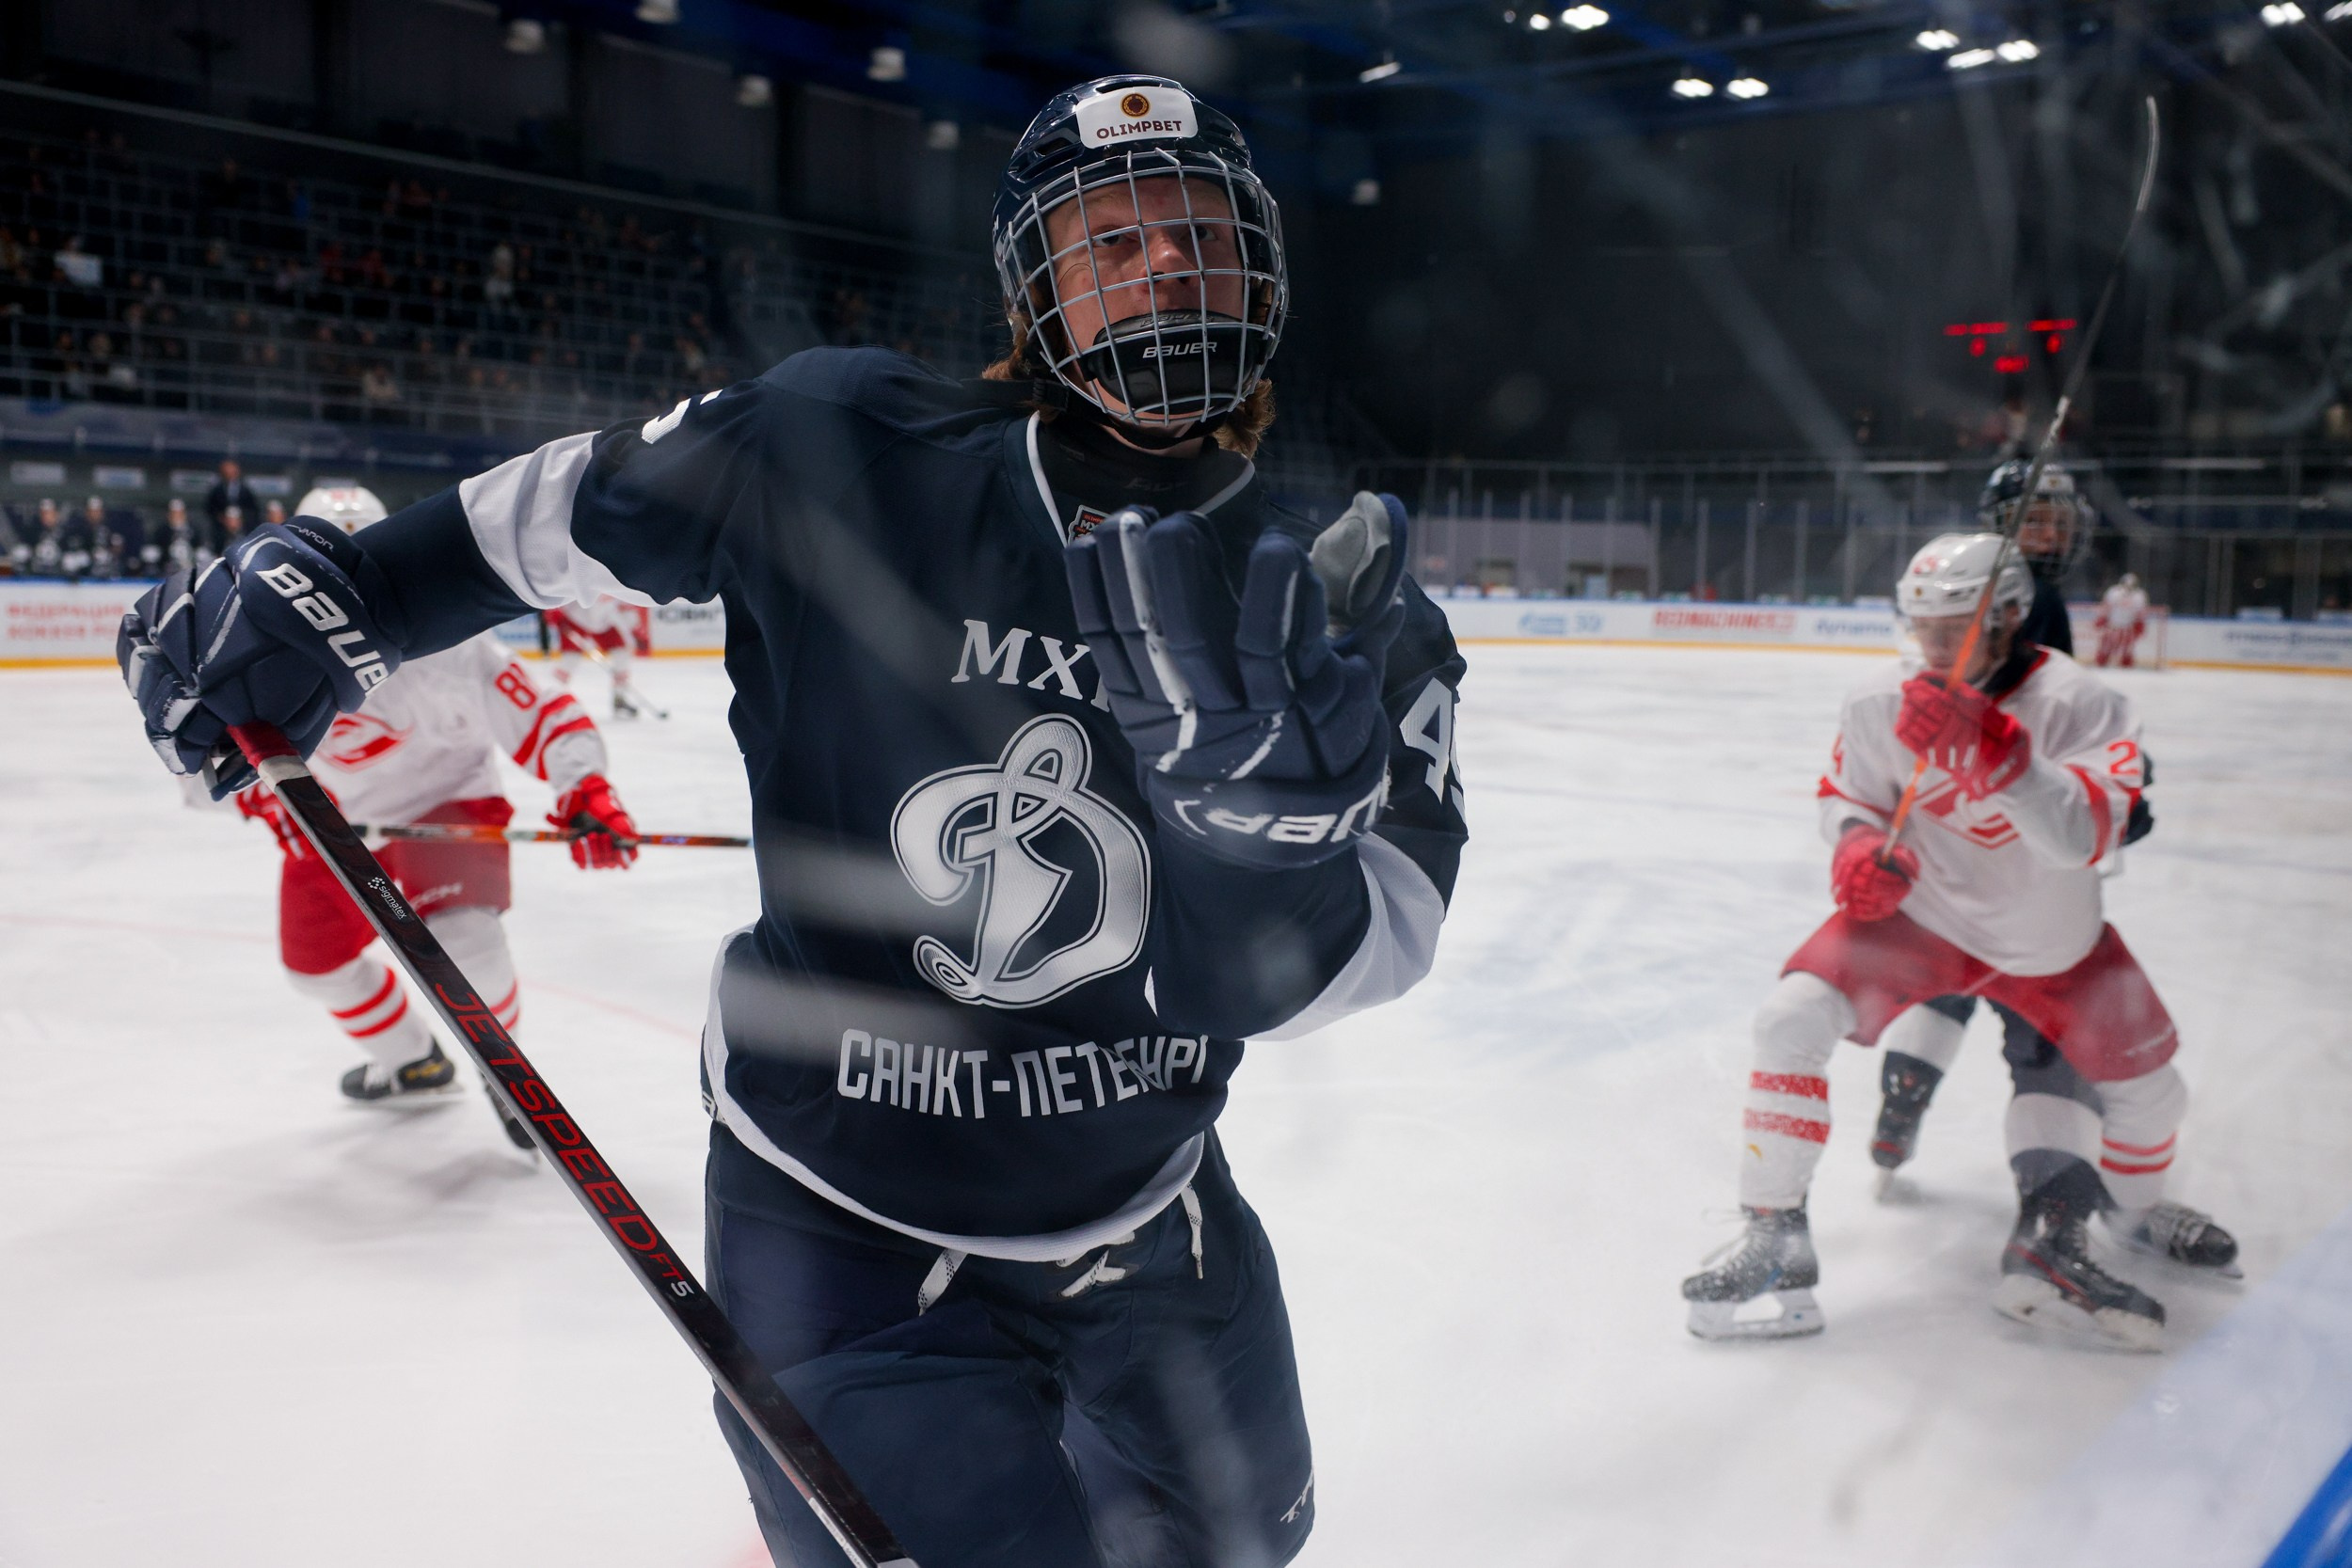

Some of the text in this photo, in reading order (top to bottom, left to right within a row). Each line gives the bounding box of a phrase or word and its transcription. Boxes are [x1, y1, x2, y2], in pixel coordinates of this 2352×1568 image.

[1096, 120, 1182, 139] OLIMPBET
[255, 562, 389, 698] BAUE
[378, 885, 407, 919] sigmatex
[436, 982, 658, 1251] JETSPEED
